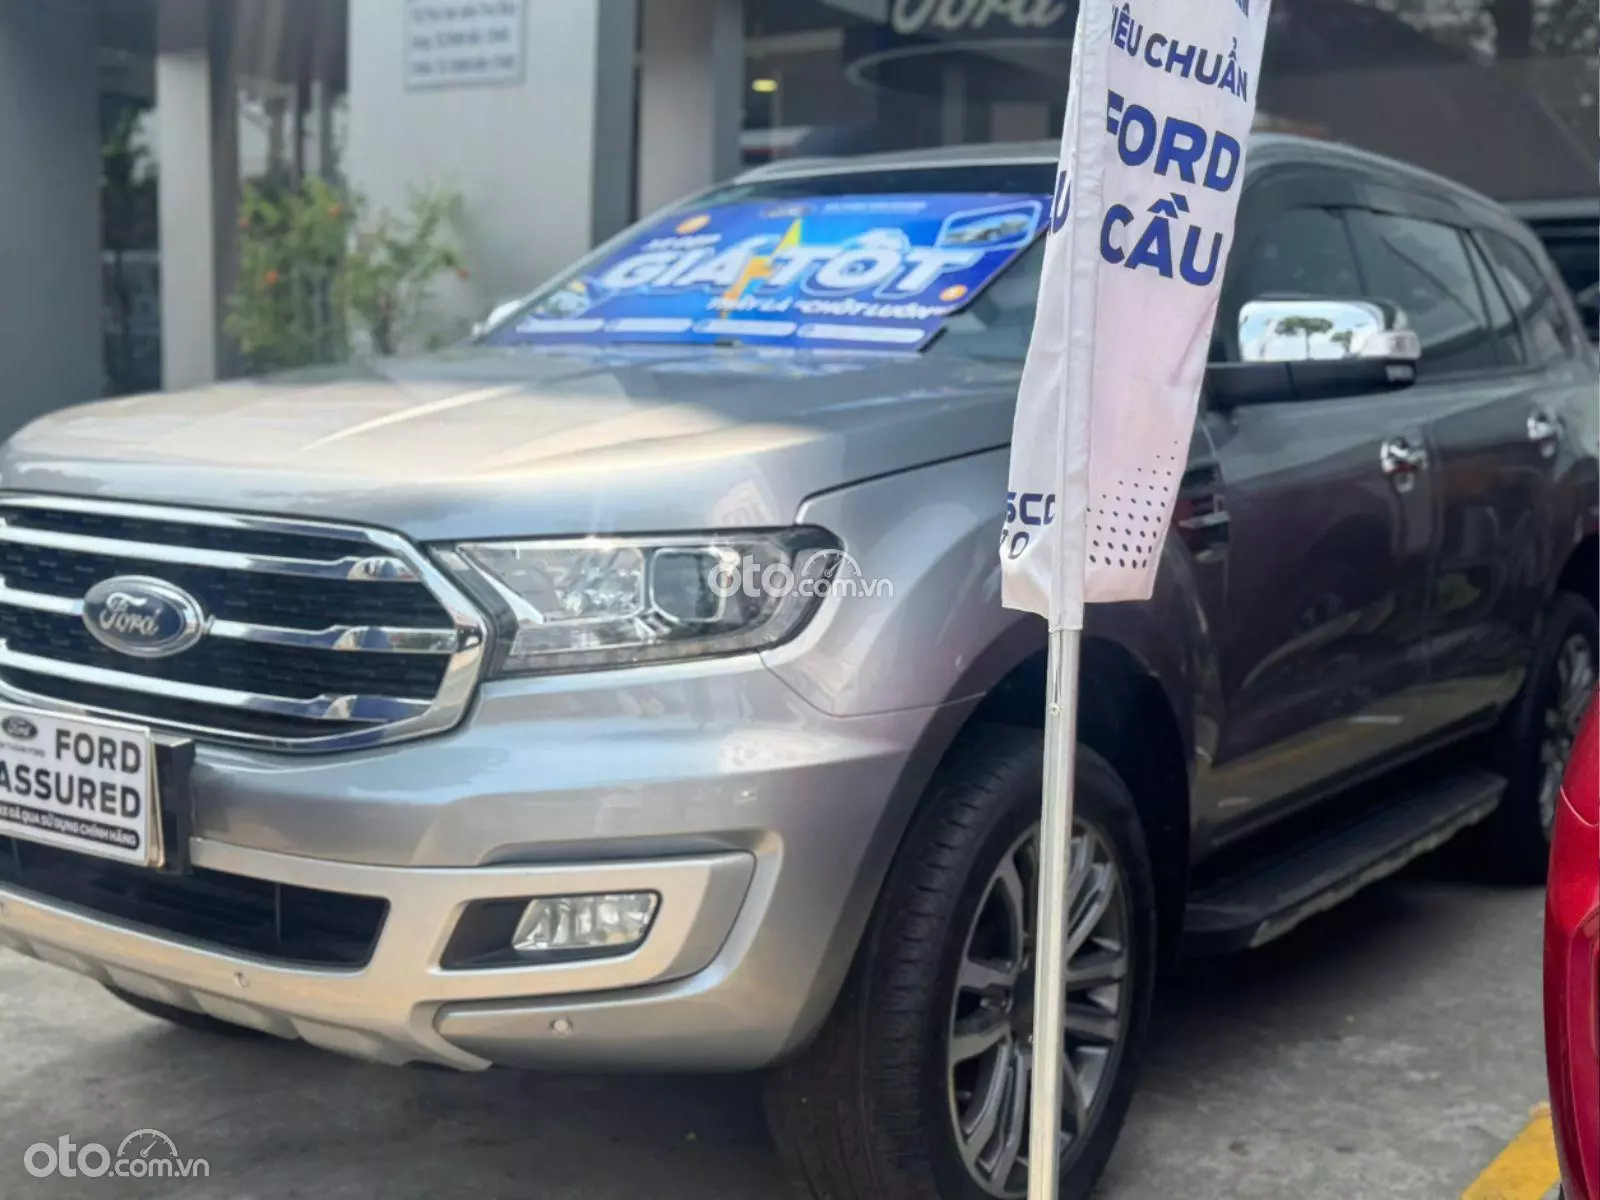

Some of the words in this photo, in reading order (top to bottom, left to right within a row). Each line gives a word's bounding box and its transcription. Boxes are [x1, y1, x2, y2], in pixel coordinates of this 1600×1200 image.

[1144, 33, 1248, 103] CHUẨN
[1106, 89, 1241, 192] FORD
[1100, 191, 1222, 287] CẦU
[99, 592, 165, 637] Ford
[55, 728, 141, 775] FORD
[0, 760, 141, 819] ASSURED
